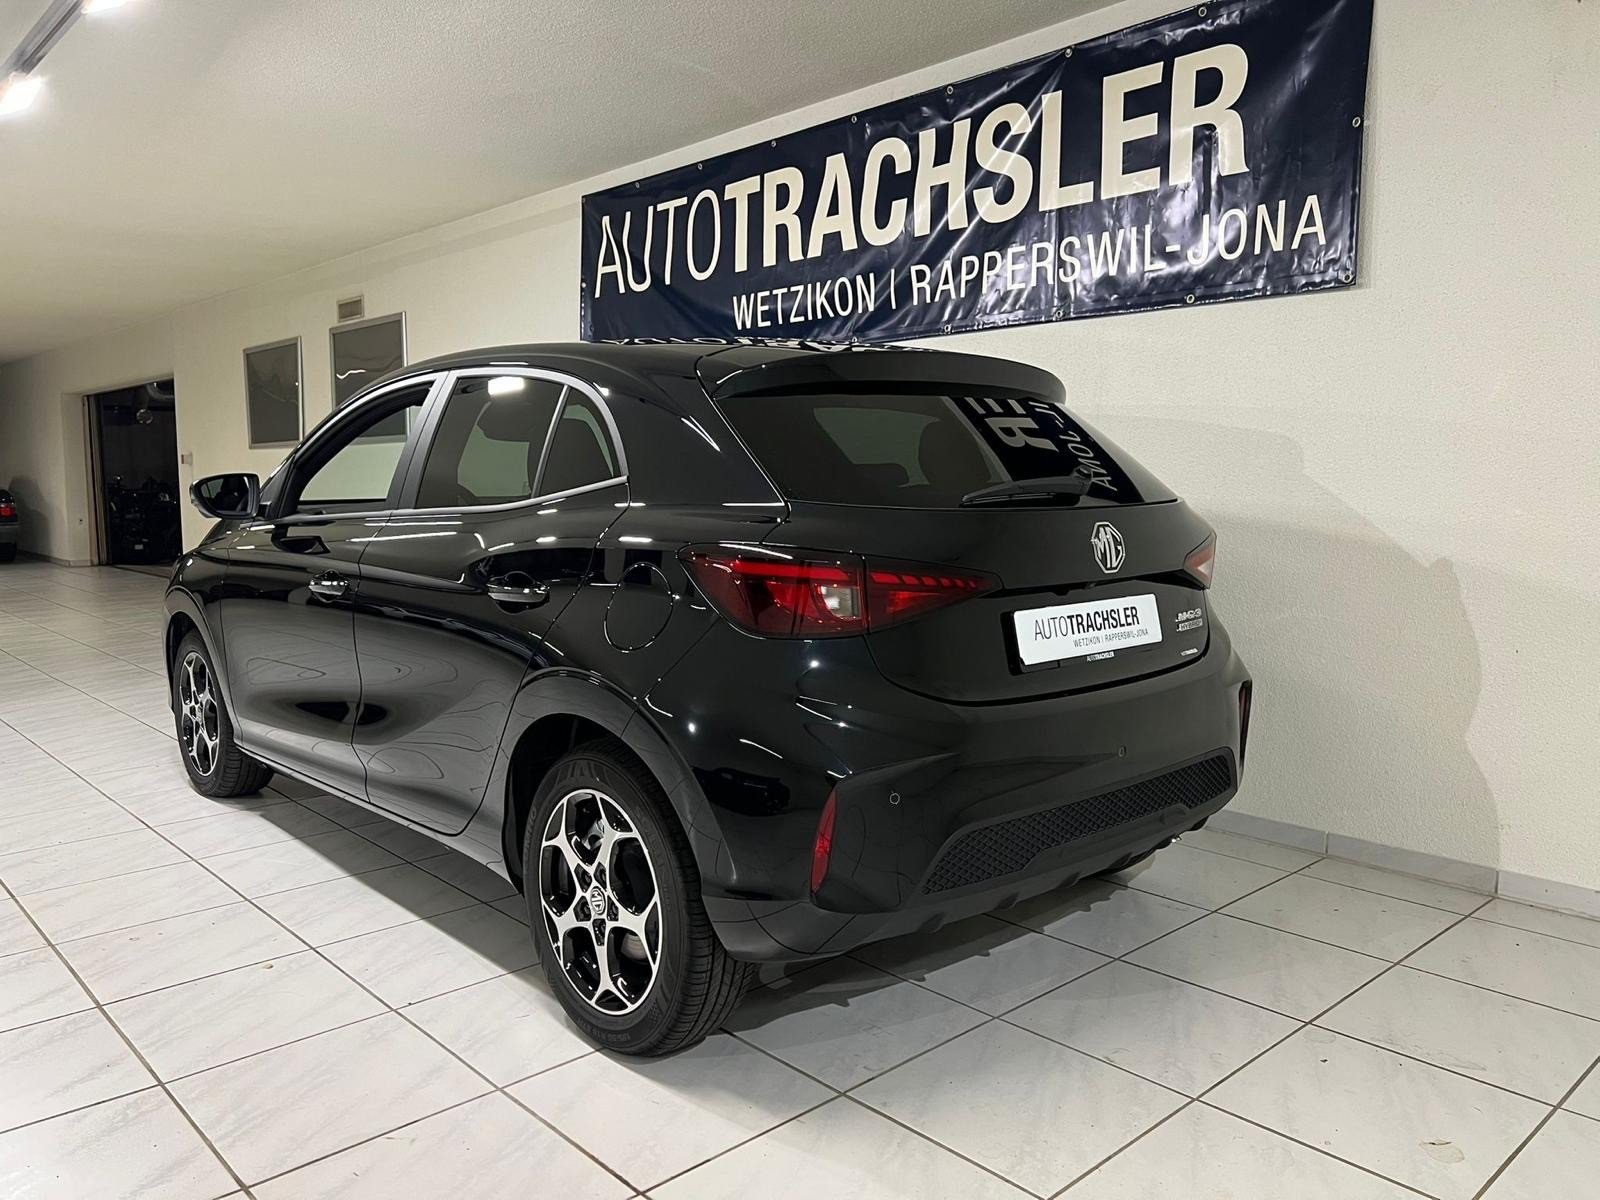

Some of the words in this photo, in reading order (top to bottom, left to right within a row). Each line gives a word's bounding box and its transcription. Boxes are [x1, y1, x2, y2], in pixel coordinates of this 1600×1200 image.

[593, 43, 1250, 299] AUTOTRACHSLER
[732, 272, 878, 331] WETZIKON
[911, 194, 1327, 304] RAPPERSWIL-JONA
[1093, 524, 1124, 571] MG
[1034, 606, 1140, 641] AUTOTRACHSLER
[1073, 637, 1101, 648] WETZIKON
[1105, 629, 1149, 642] RAPPERSWIL-JONA
